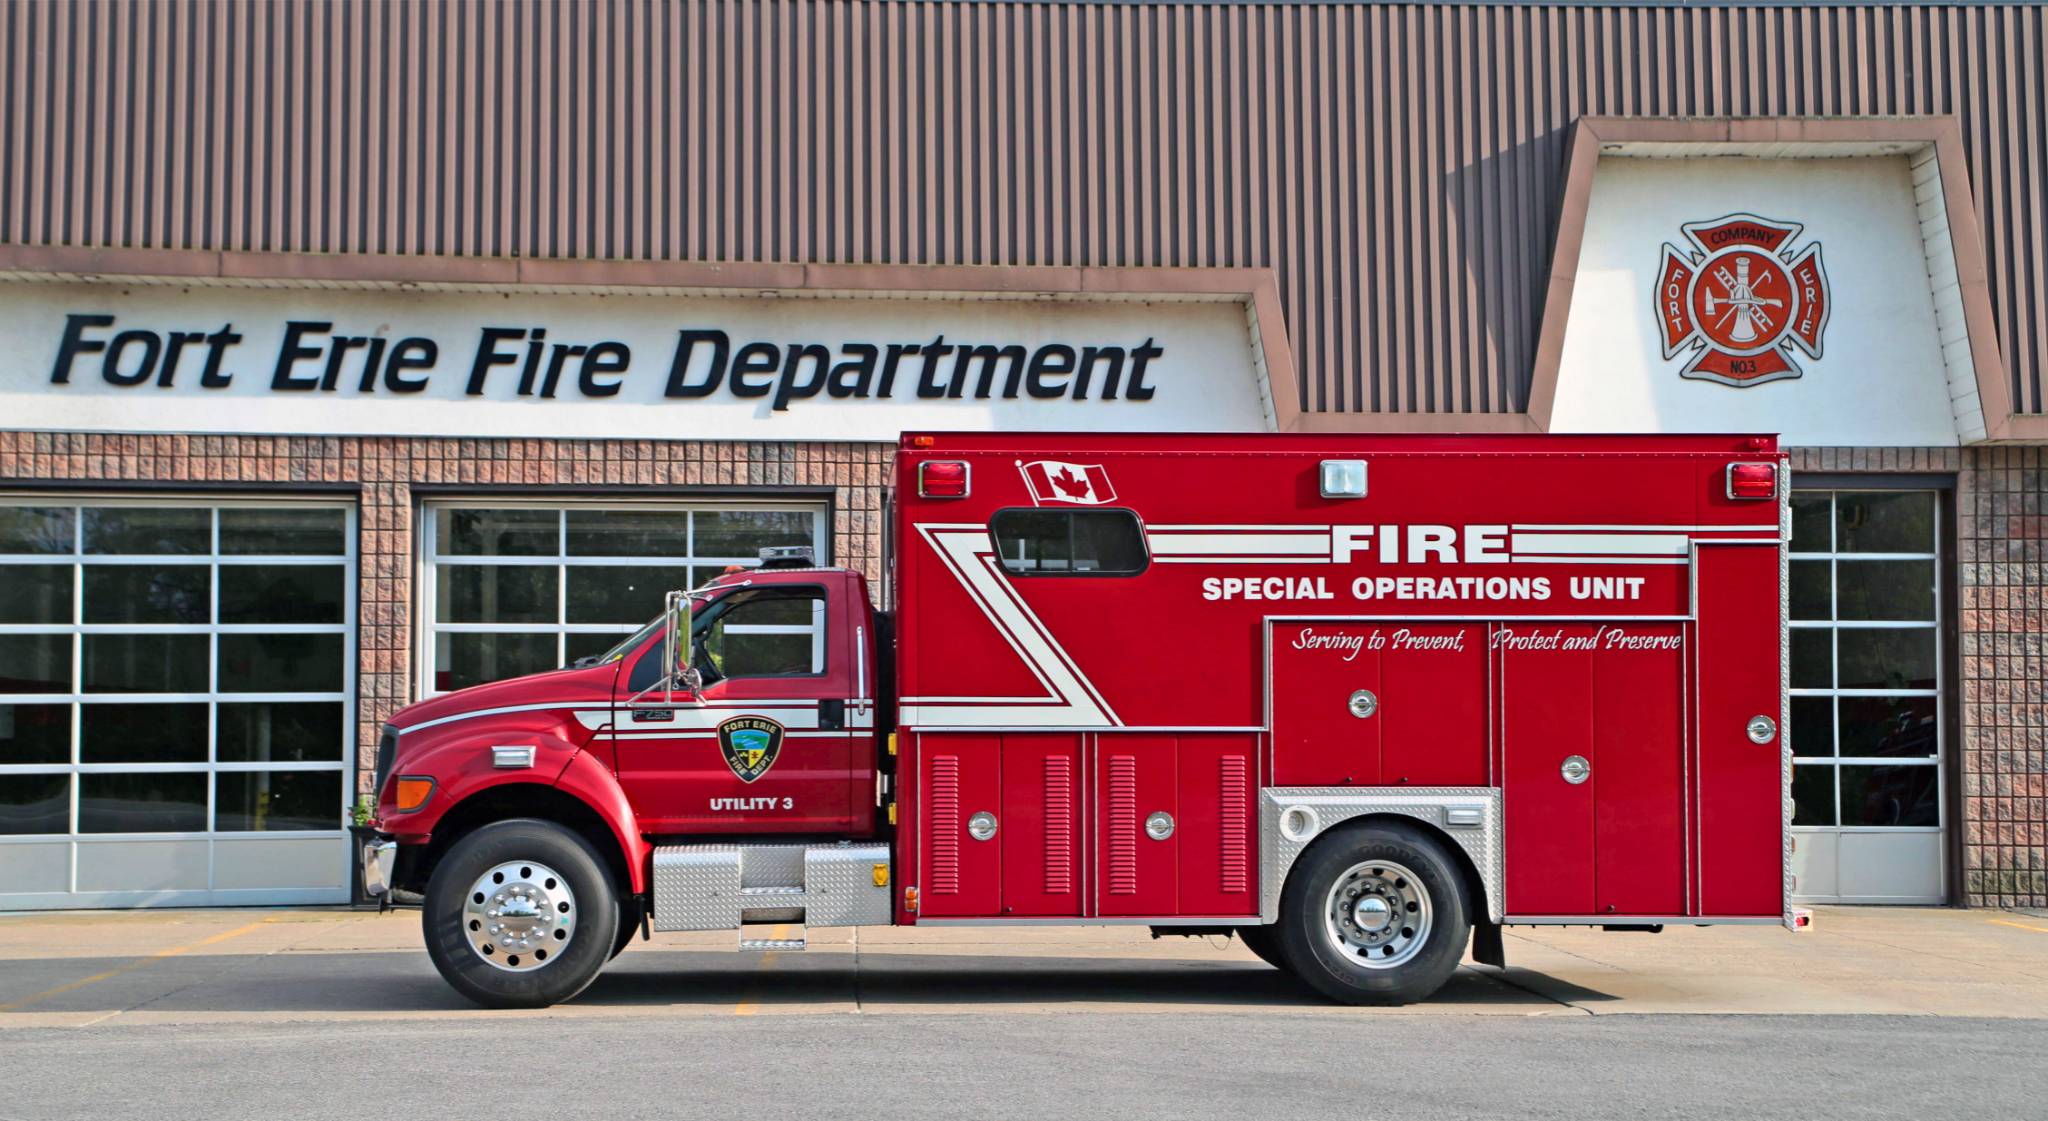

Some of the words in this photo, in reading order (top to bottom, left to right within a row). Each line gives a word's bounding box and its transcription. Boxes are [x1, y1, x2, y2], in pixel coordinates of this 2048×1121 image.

[1710, 225, 1776, 245] COMPANY
[1668, 268, 1684, 332] FORT
[1799, 268, 1816, 335] ERIE
[51, 315, 242, 388] Fort
[271, 322, 437, 393] Erie
[466, 328, 630, 398] Fire
[665, 330, 1163, 411] Department
[1332, 524, 1510, 564] FIRE
[1202, 577, 1334, 600] SPECIAL
[1351, 577, 1551, 600] OPERATIONS
[1569, 577, 1645, 600] UNIT
[1292, 627, 1365, 662] Serving
[1368, 629, 1385, 650] to
[1391, 628, 1465, 653] Prevent,
[1492, 628, 1563, 650] Protect
[1562, 625, 1606, 650] and
[1605, 628, 1682, 650] Preserve
[723, 720, 750, 733] FORT
[752, 720, 777, 734] ERIE
[729, 756, 748, 775] FIRE
[750, 754, 773, 776] DEPT.
[709, 797, 777, 811] UTILITY
[782, 797, 793, 810] 3
